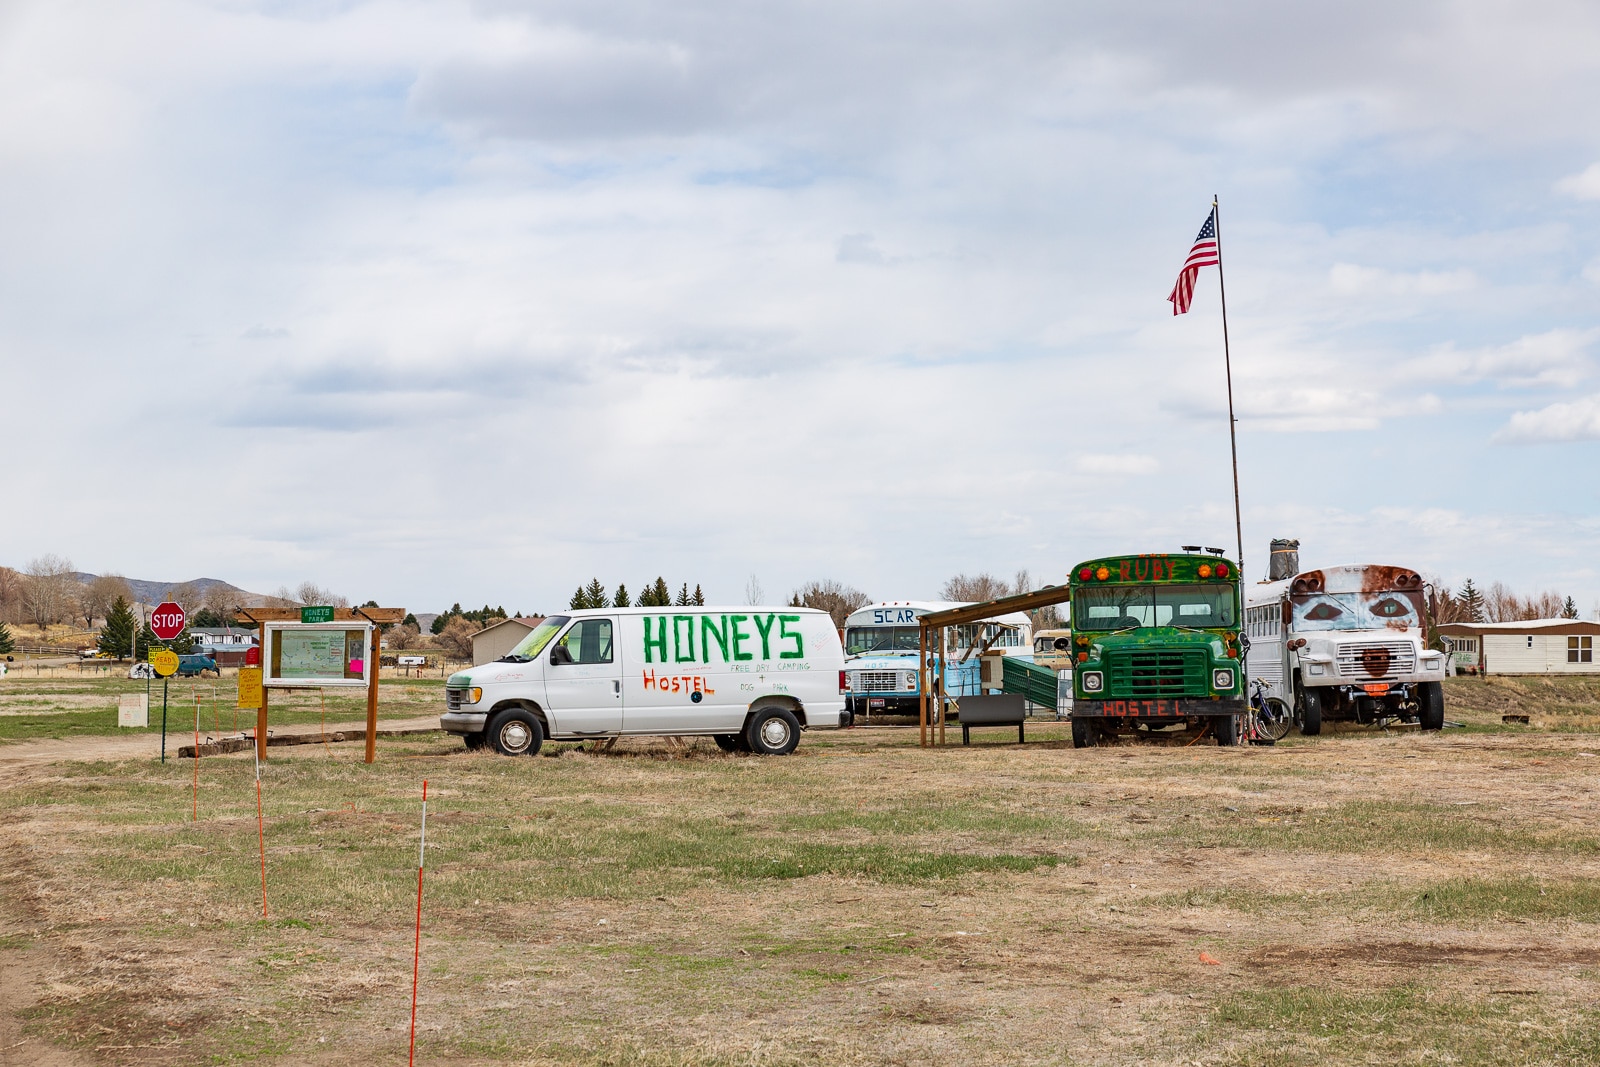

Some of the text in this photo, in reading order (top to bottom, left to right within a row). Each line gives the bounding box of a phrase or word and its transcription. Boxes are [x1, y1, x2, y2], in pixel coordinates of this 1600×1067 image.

[1119, 559, 1176, 582] RUBY
[153, 613, 183, 628] STOP
[874, 609, 914, 623] SCAR
[643, 612, 804, 664] HONEYS
[730, 662, 811, 672] FREE DRY CAMPING
[643, 668, 715, 695] HOSTEL
[740, 683, 789, 692] DOG PARK
[1103, 700, 1184, 717] HOSTEL
